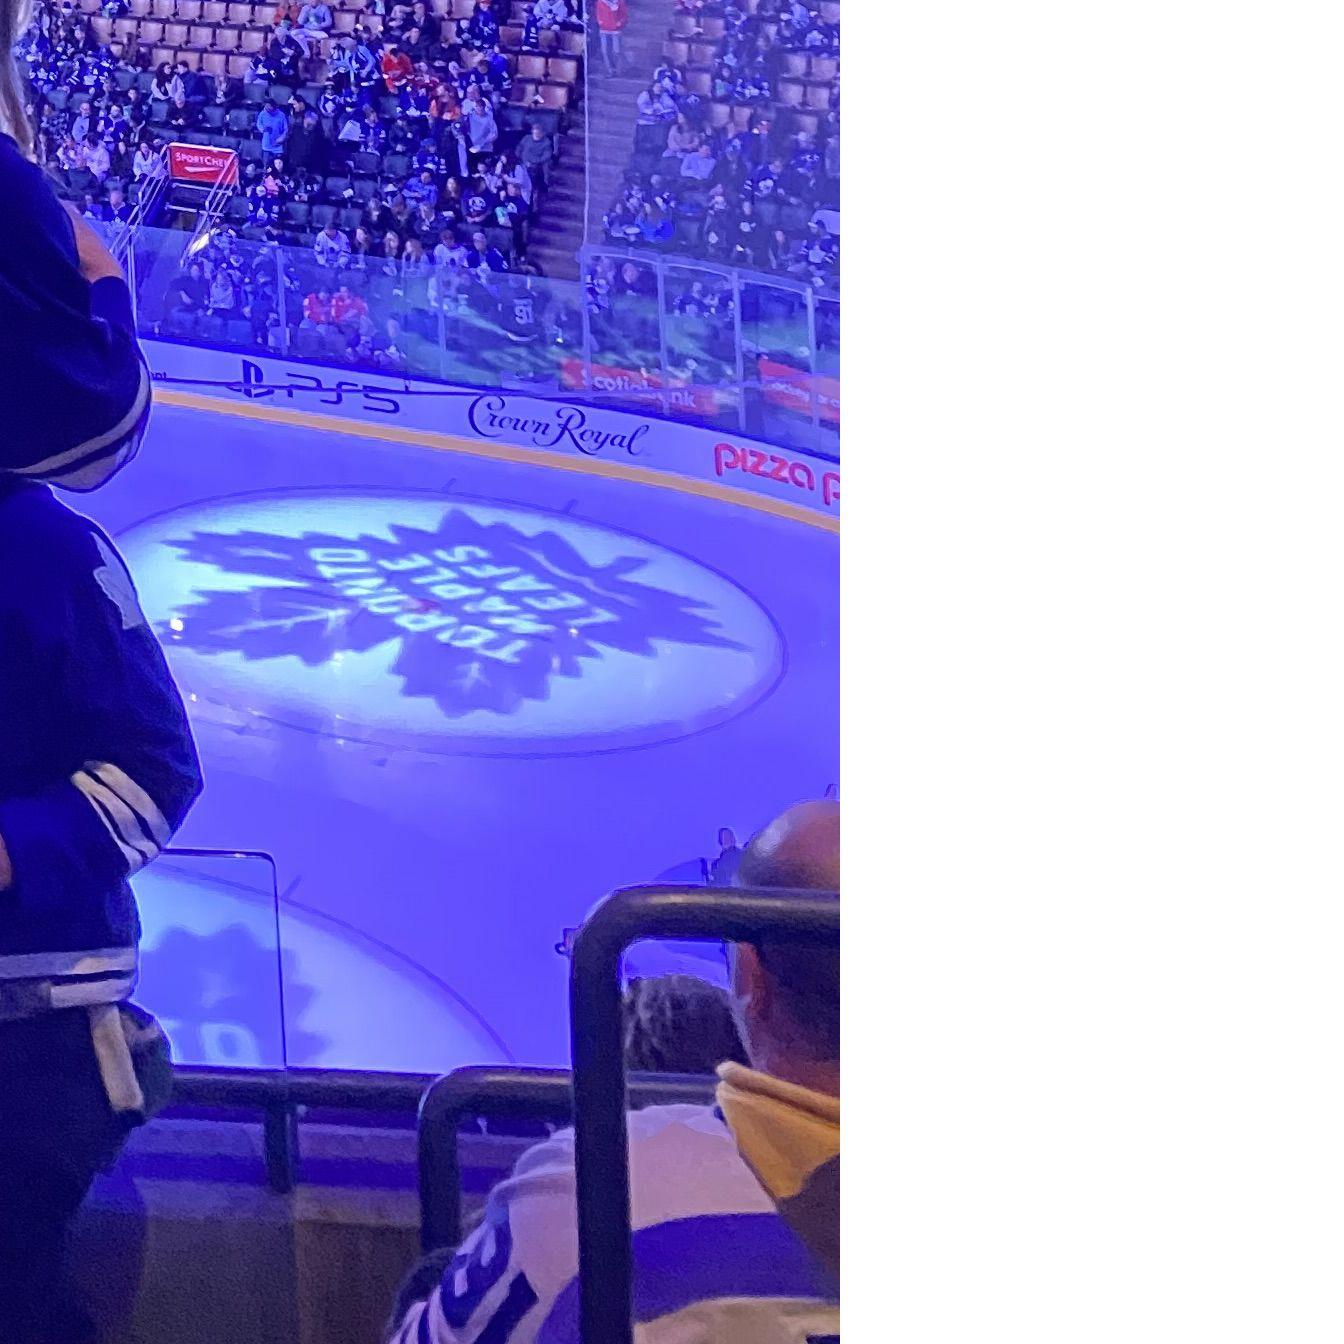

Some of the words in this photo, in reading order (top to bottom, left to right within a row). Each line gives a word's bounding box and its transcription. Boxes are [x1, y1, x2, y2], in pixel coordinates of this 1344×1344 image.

[284, 372, 400, 414] PS5
[468, 395, 550, 438] Crown
[532, 406, 650, 456] Royal
[308, 547, 533, 663] TORONTO
[375, 553, 558, 635] MAPLE
[432, 544, 620, 628] LEAFS
